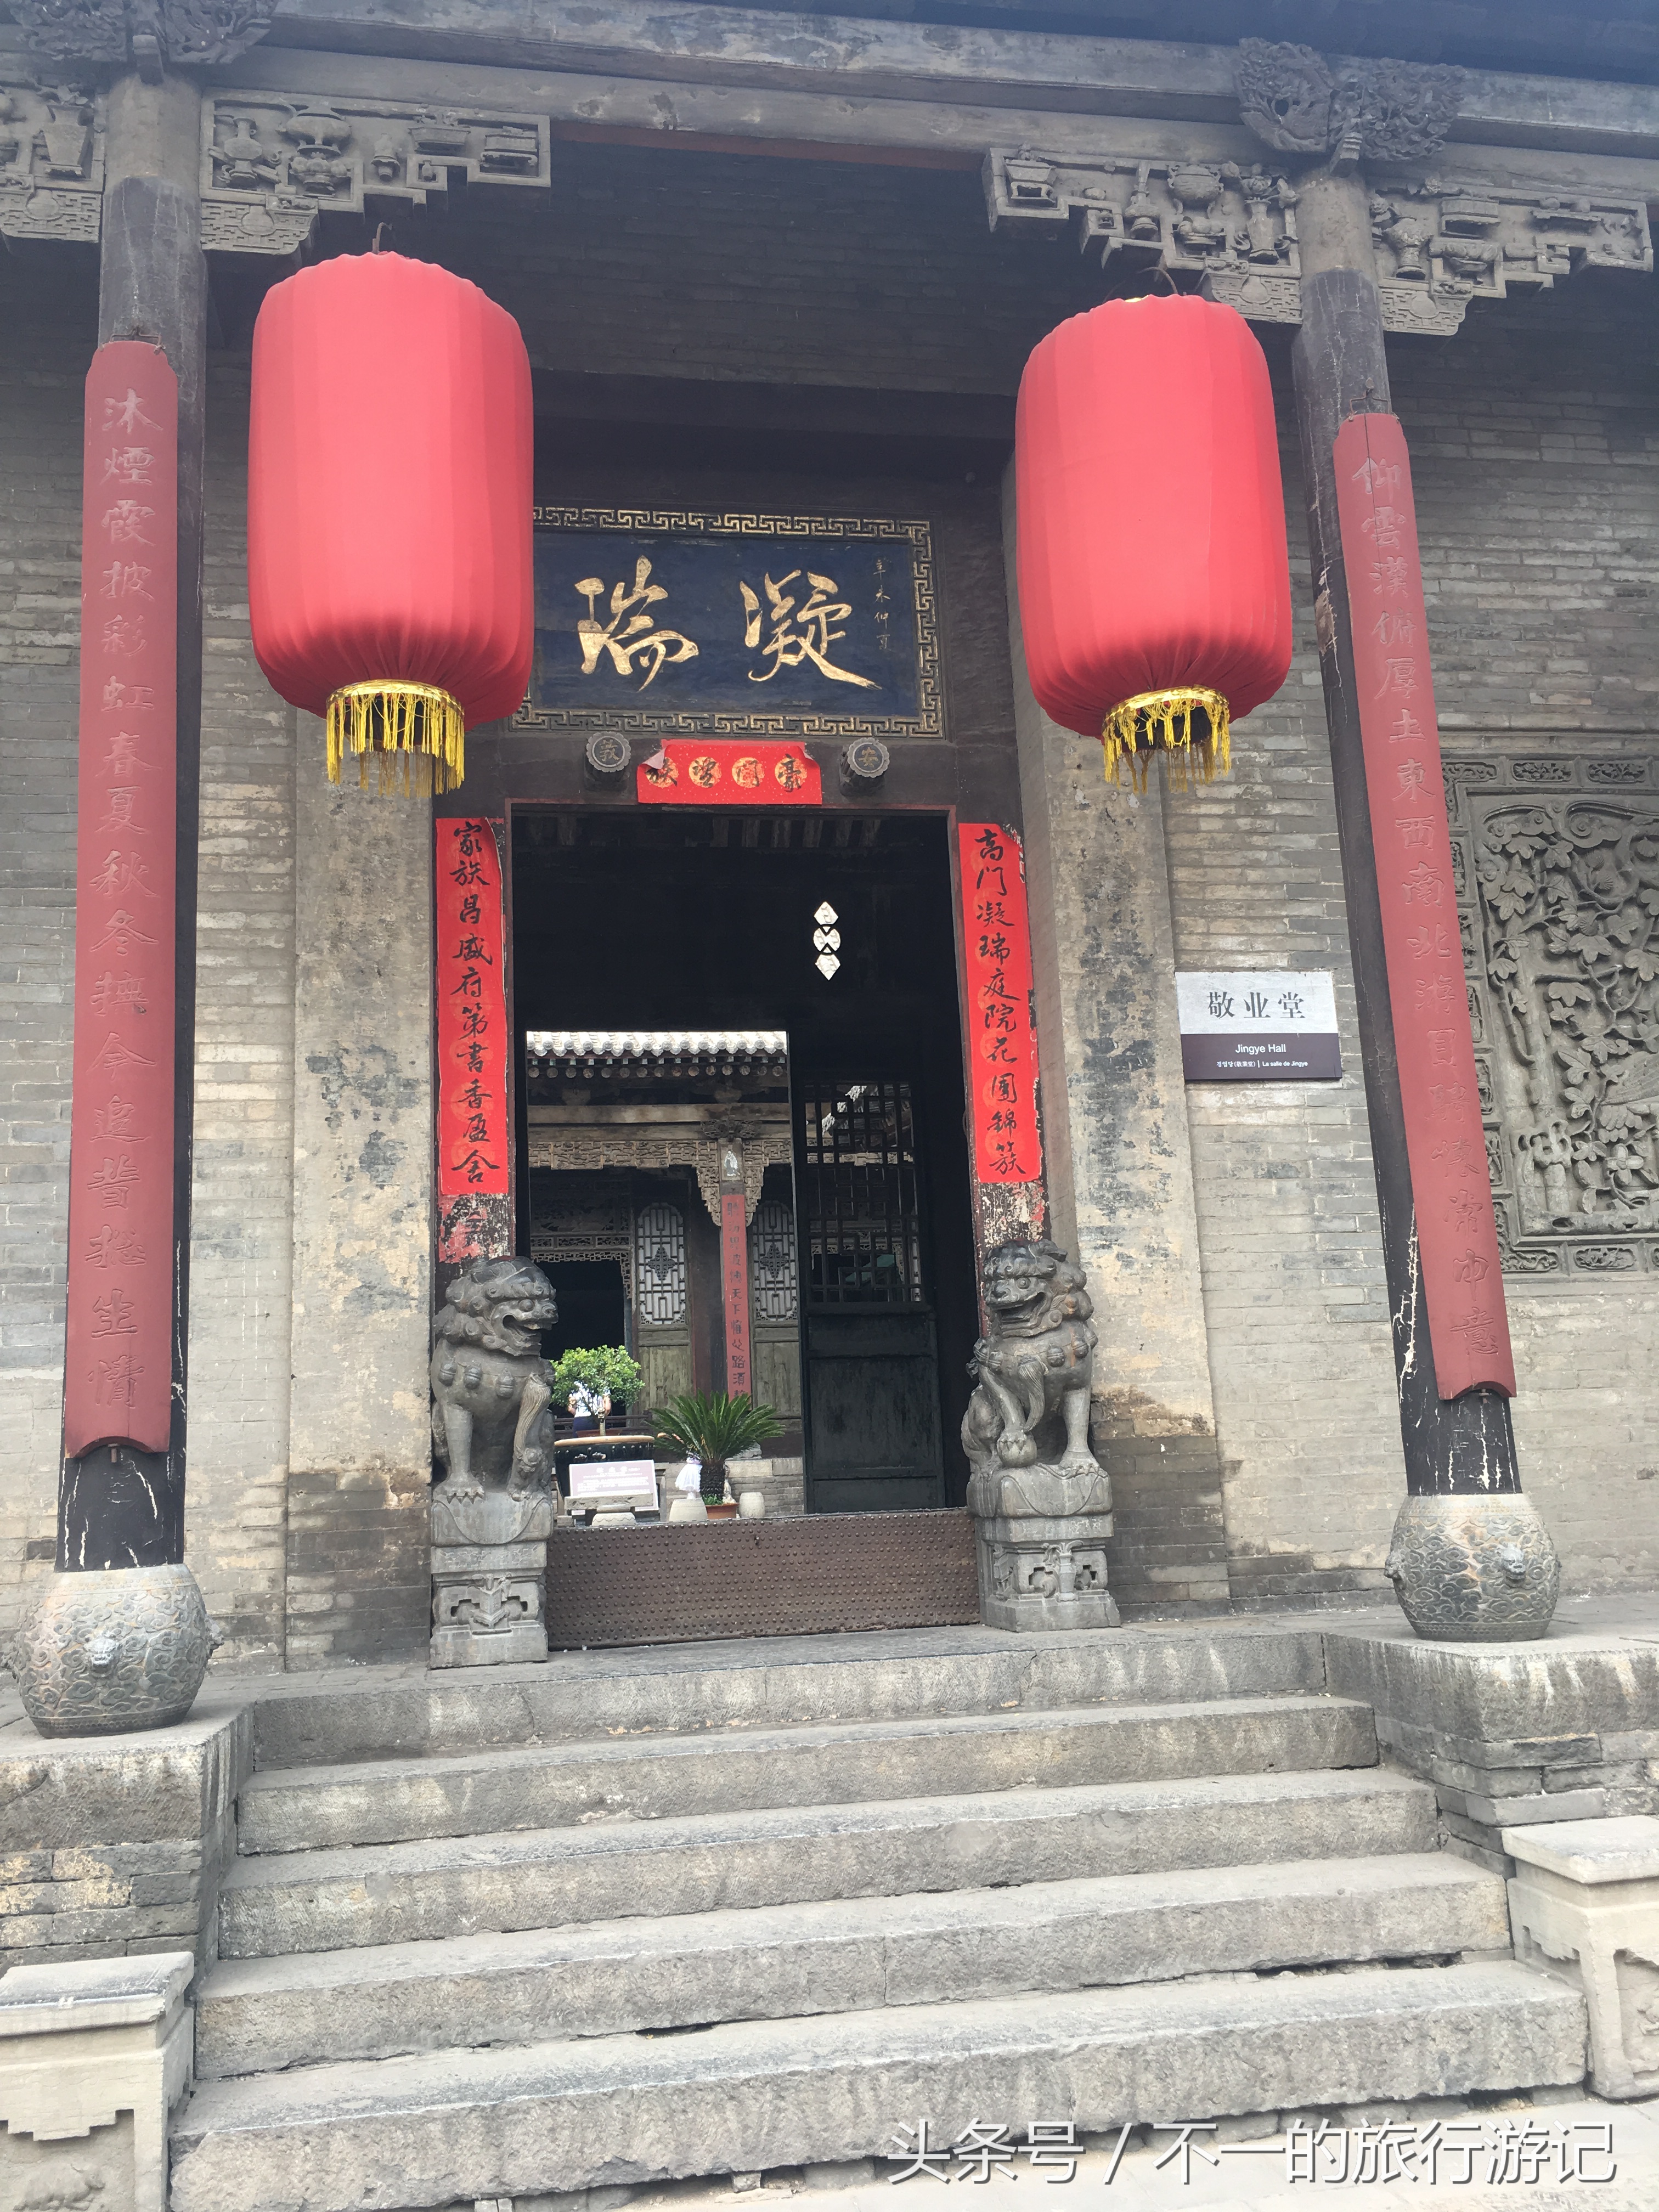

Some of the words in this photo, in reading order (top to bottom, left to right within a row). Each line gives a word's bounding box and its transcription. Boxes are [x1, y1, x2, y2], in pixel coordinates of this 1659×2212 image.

[1206, 991, 1305, 1019] 敬业堂
[1235, 1044, 1266, 1055] Jingye
[1268, 1043, 1286, 1053] Hall
